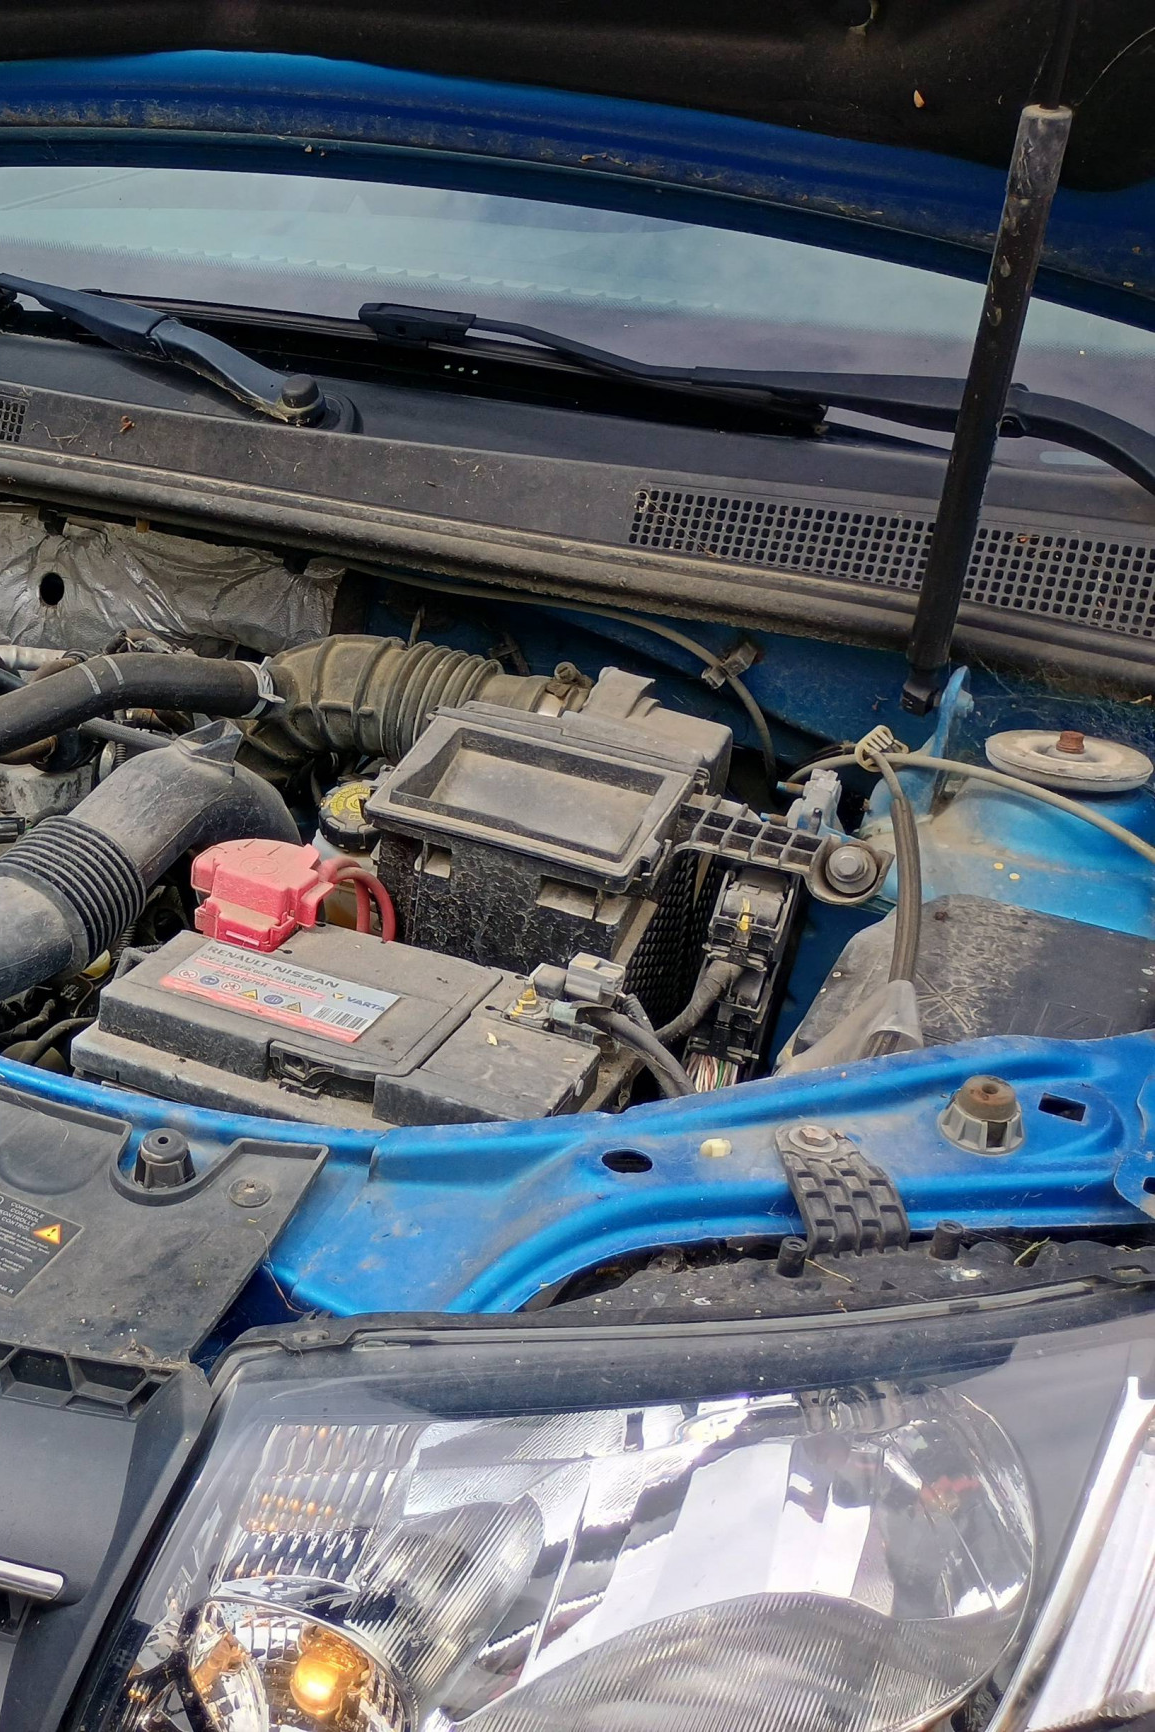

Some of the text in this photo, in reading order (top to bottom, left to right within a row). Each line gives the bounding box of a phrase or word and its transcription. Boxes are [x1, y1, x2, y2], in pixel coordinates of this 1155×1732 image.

[206, 945, 272, 969] RENAULT
[272, 965, 340, 989] NISSAN
[344, 996, 387, 1012] VARTA
[10, 1202, 45, 1218] CONTROLE
[10, 1208, 40, 1222] CONTROL
[1, 1217, 31, 1231] CONTROL
